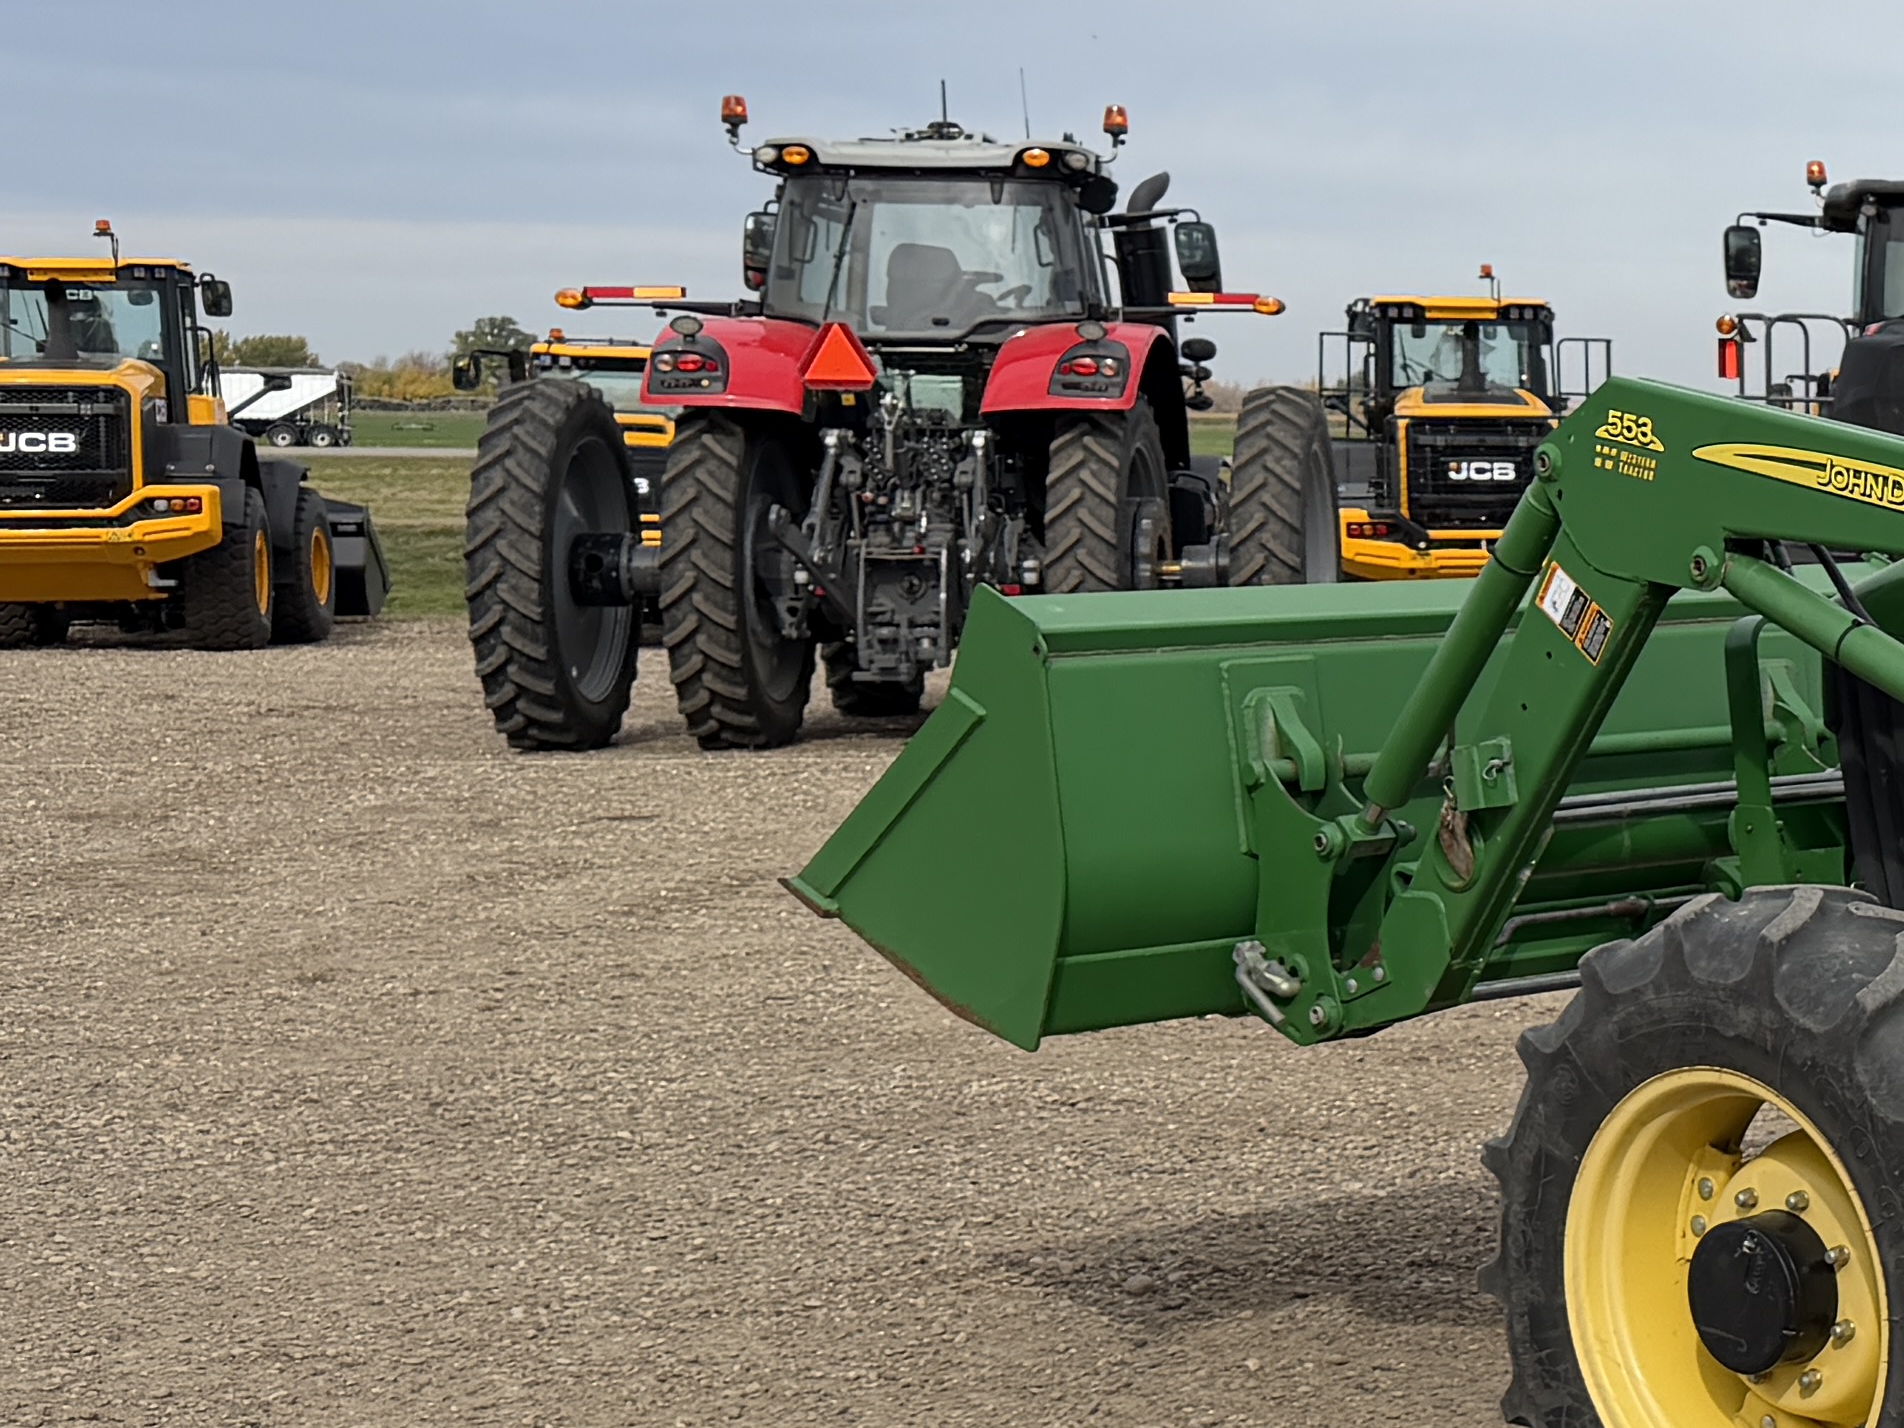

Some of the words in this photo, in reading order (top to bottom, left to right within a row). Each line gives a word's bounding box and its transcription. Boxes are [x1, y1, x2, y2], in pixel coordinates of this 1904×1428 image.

[66, 288, 93, 301] CB
[1608, 409, 1653, 444] 553
[1448, 461, 1516, 481] JCB
[1816, 458, 1884, 502] JOHN
